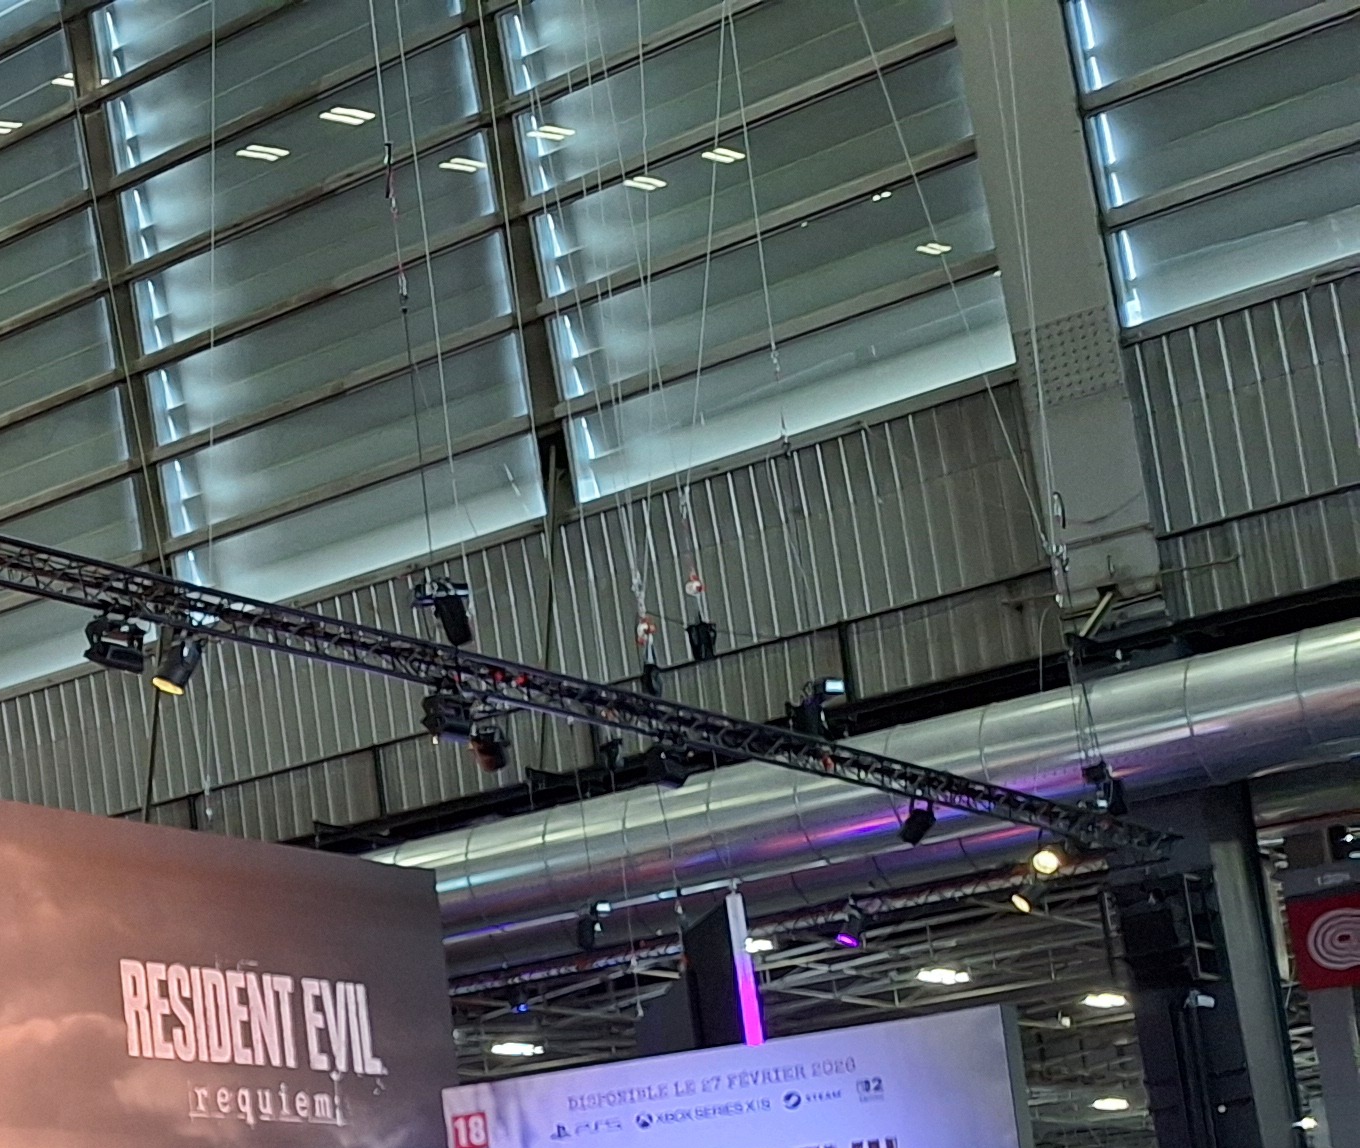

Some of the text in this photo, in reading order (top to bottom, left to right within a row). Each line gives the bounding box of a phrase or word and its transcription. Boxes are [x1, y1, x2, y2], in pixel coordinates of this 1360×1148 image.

[120, 959, 384, 1076] RESIDENT EVIL
[193, 1082, 331, 1128] requiem
[568, 1084, 669, 1111] DISPONIBLE
[674, 1079, 697, 1098] LE
[453, 1115, 486, 1147] 18
